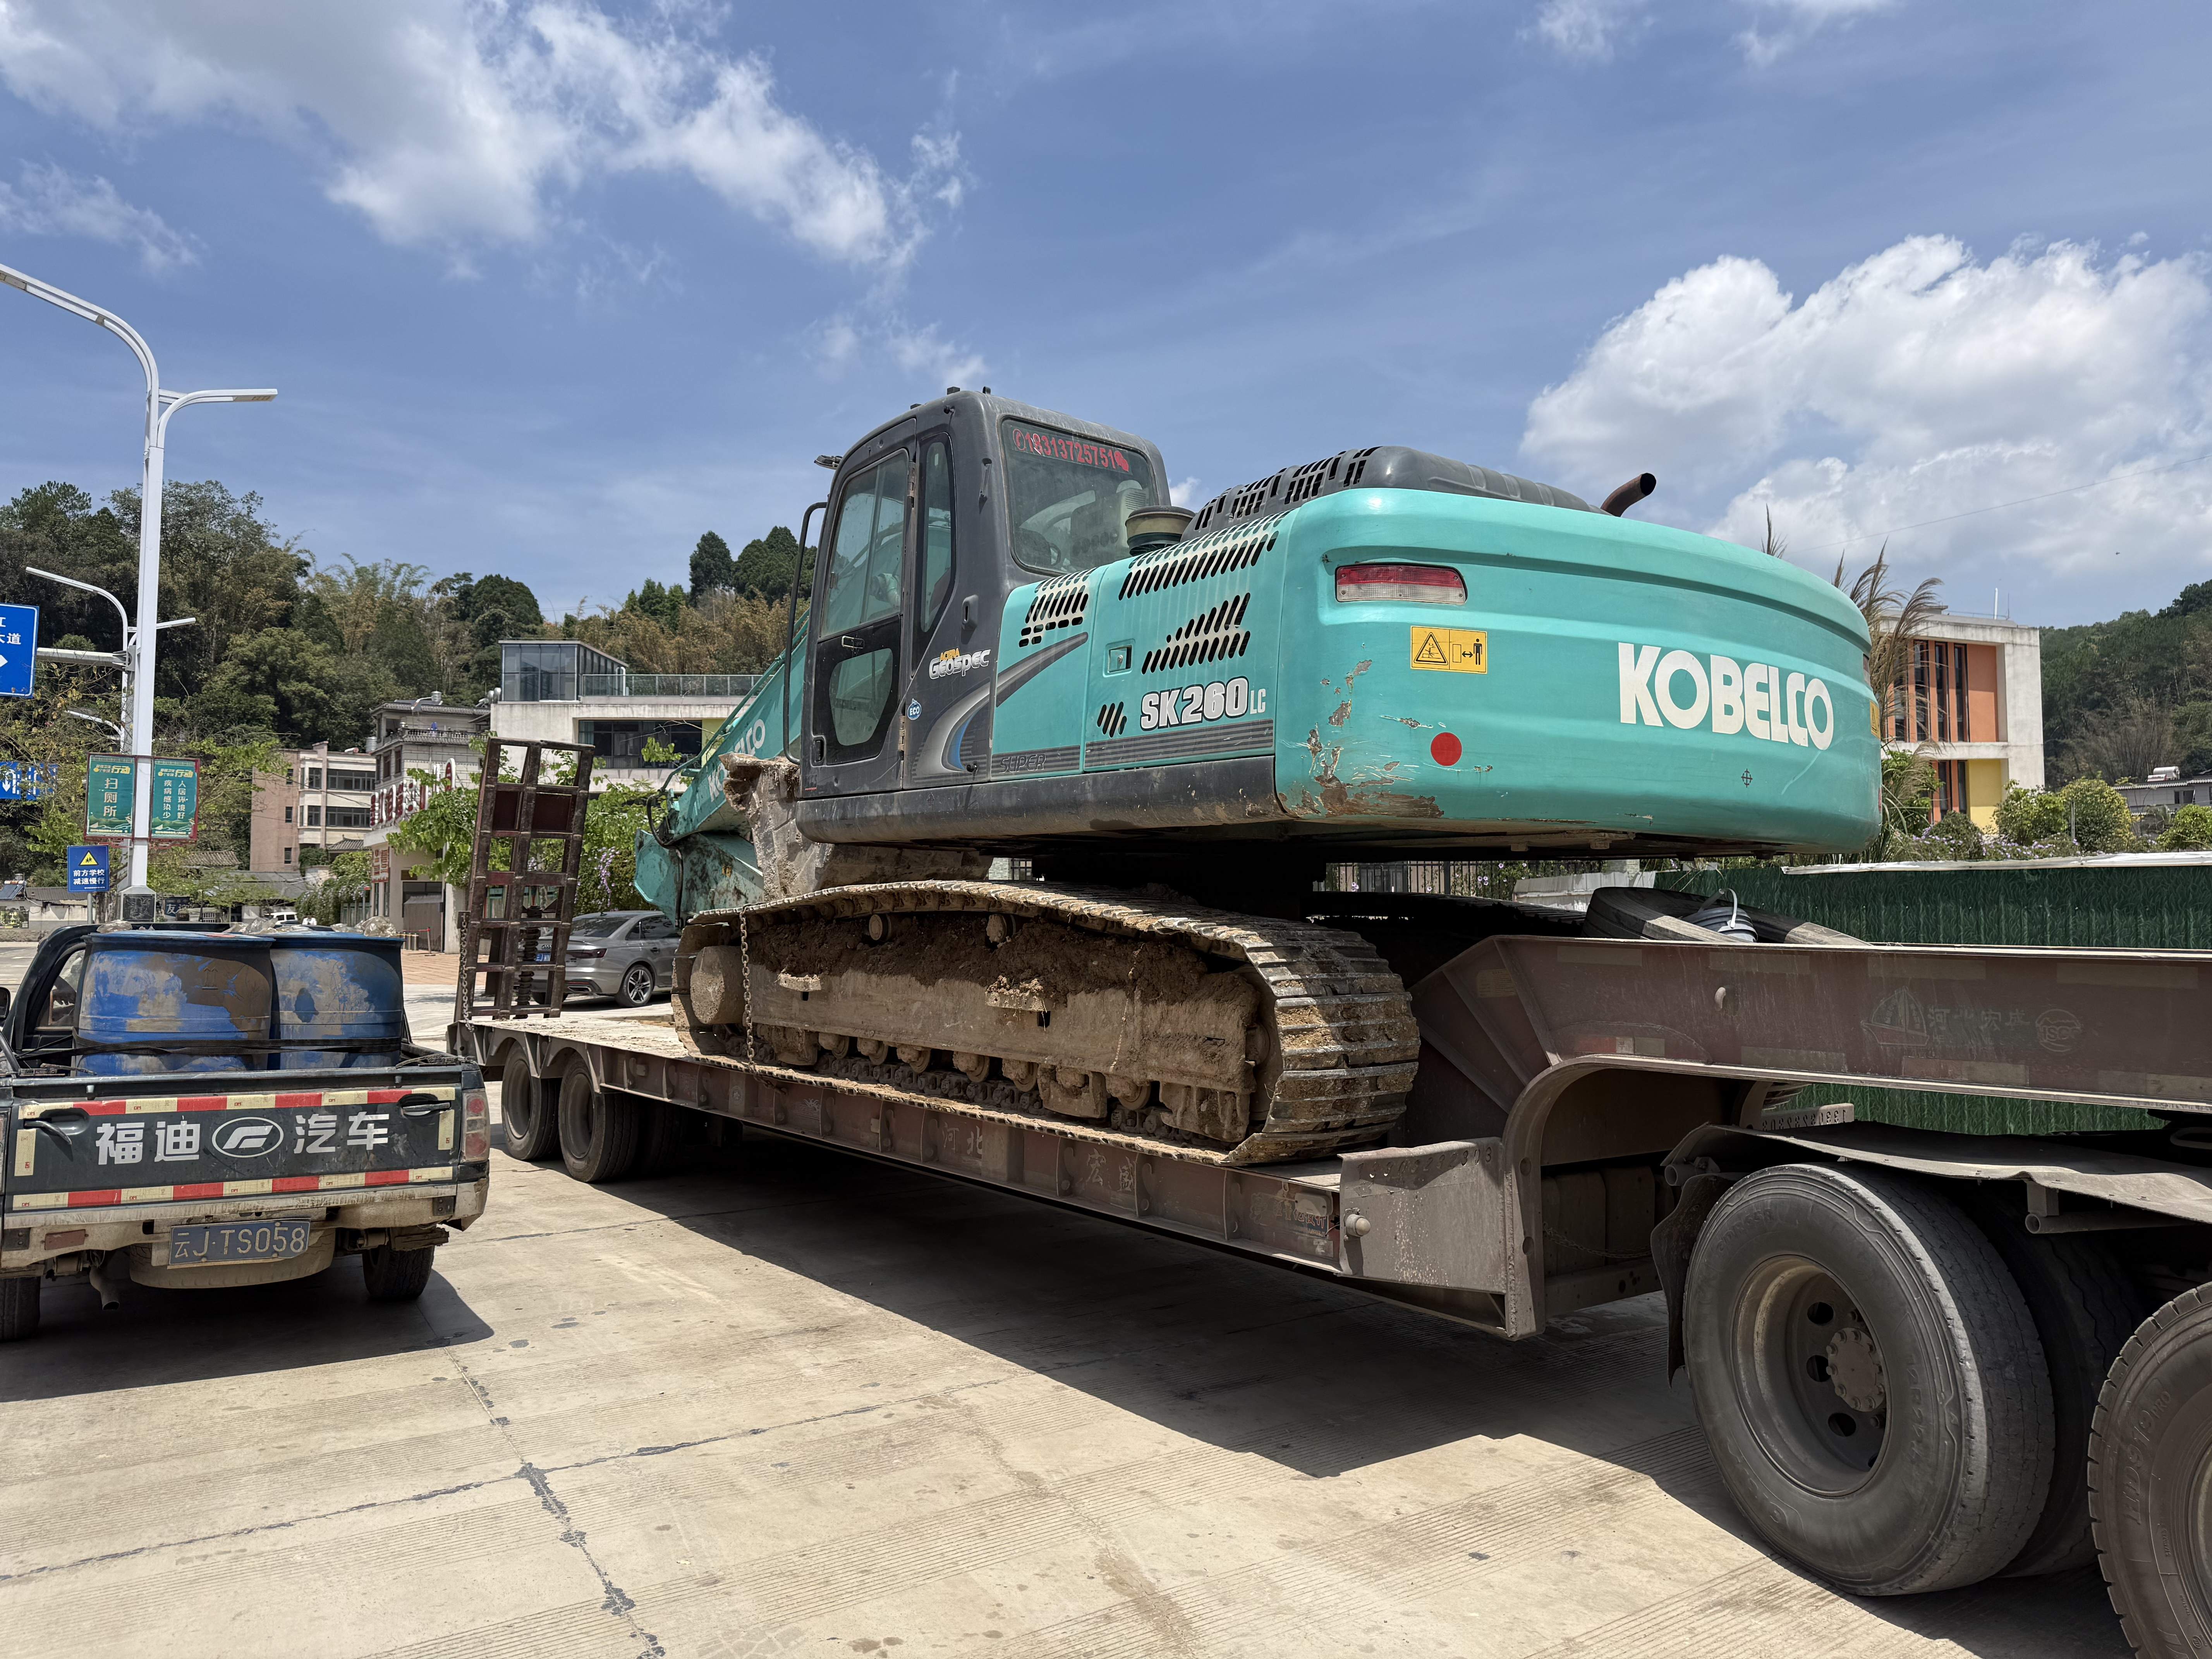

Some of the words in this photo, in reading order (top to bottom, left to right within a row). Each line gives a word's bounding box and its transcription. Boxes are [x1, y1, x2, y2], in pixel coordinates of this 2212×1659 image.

[1025, 431, 1116, 469] 18313725751
[910, 706, 920, 716] ECO
[1141, 676, 1249, 731] SK260
[1250, 688, 1266, 714] LC
[1618, 642, 1834, 750] KOBELCO
[999, 754, 1046, 773] SUPER
[103, 778, 118, 817] 扫厕所
[163, 780, 172, 818] 疾病感染少
[177, 780, 186, 819] 人居环境好
[96, 1120, 200, 1165] 福迪
[294, 1111, 389, 1154] 汽车
